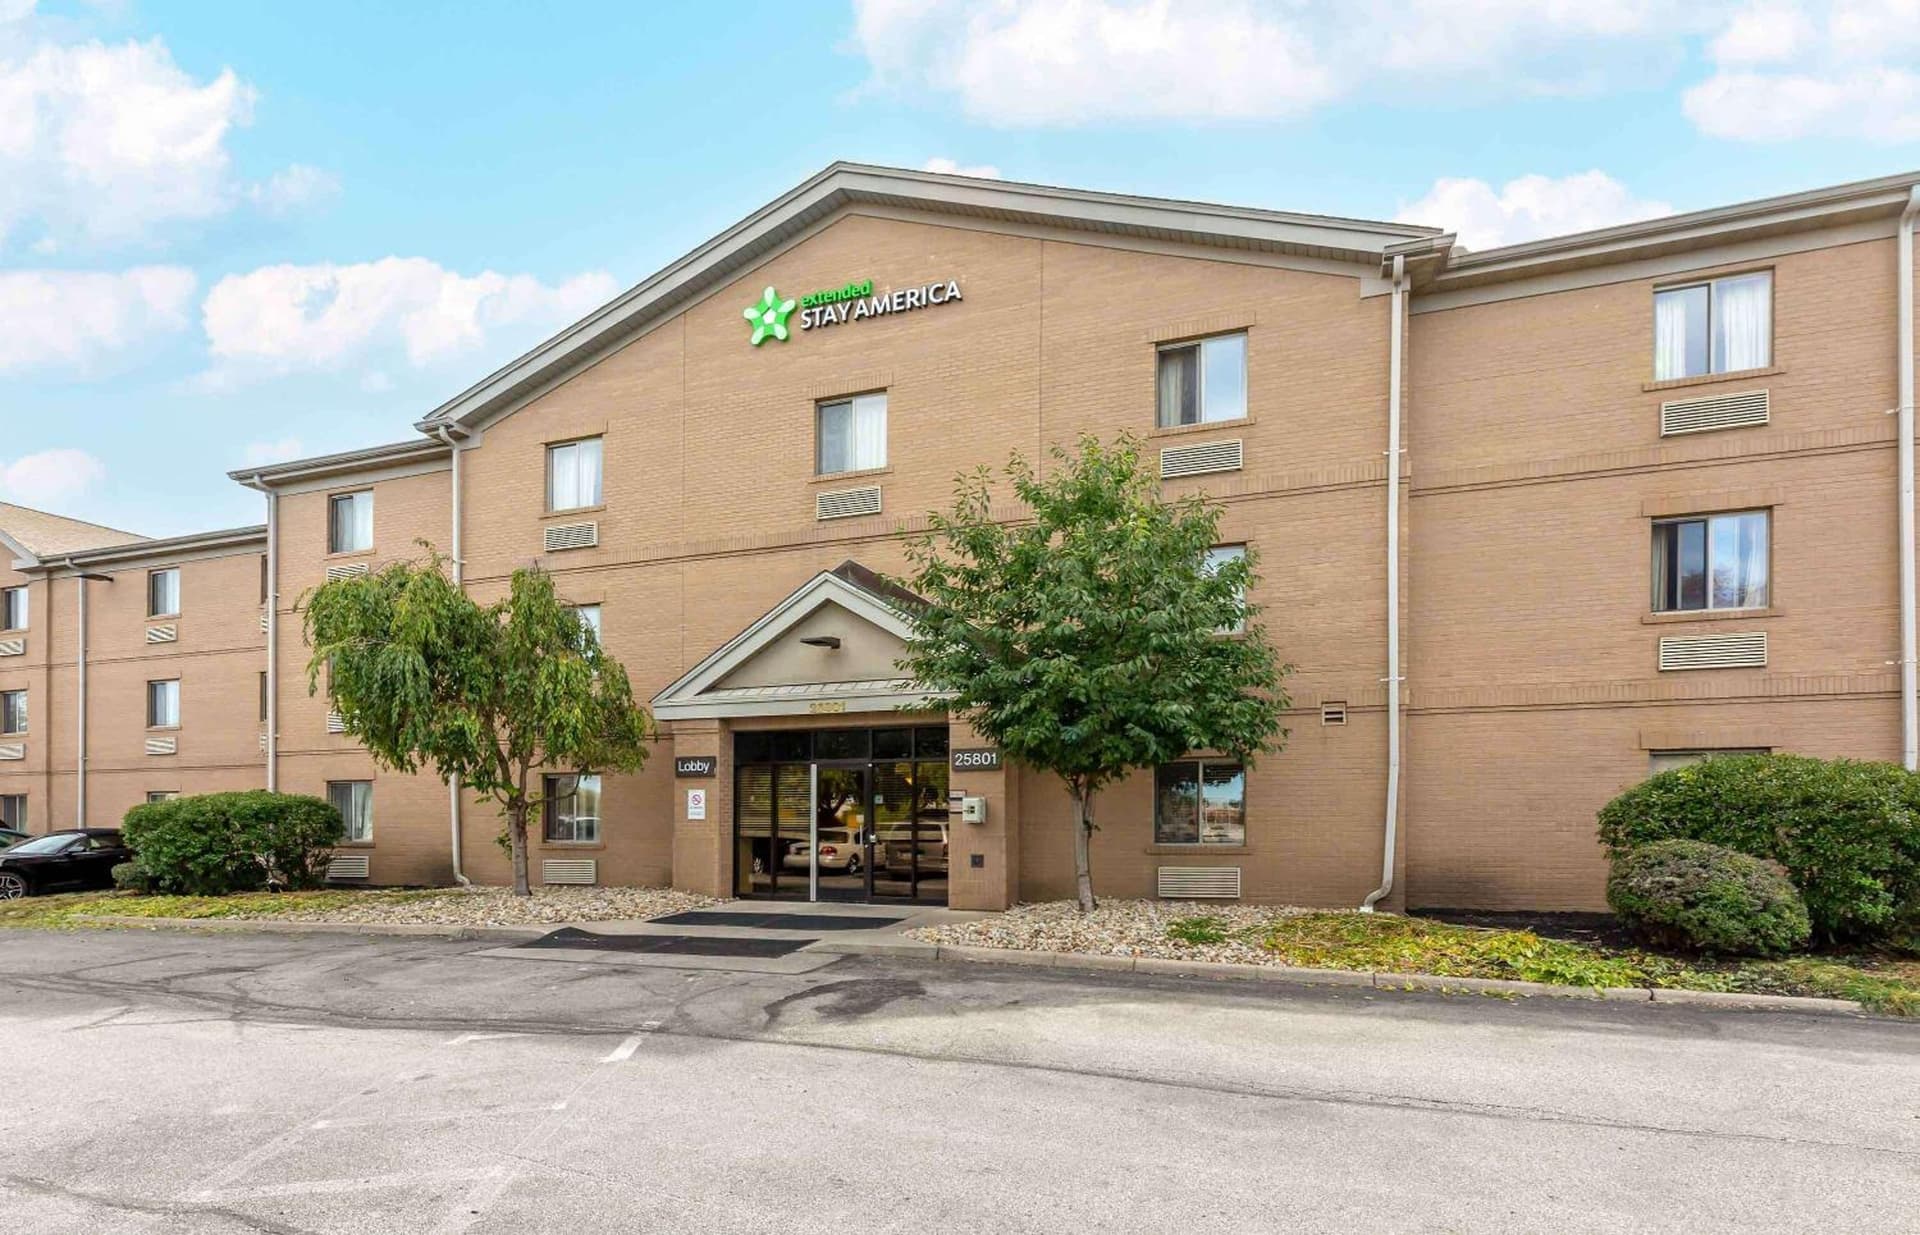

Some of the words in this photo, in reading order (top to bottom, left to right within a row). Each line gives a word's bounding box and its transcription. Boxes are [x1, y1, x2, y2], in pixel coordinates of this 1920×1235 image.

[801, 280, 872, 308] extended
[955, 752, 997, 765] 25801
[678, 760, 710, 774] Lobby
